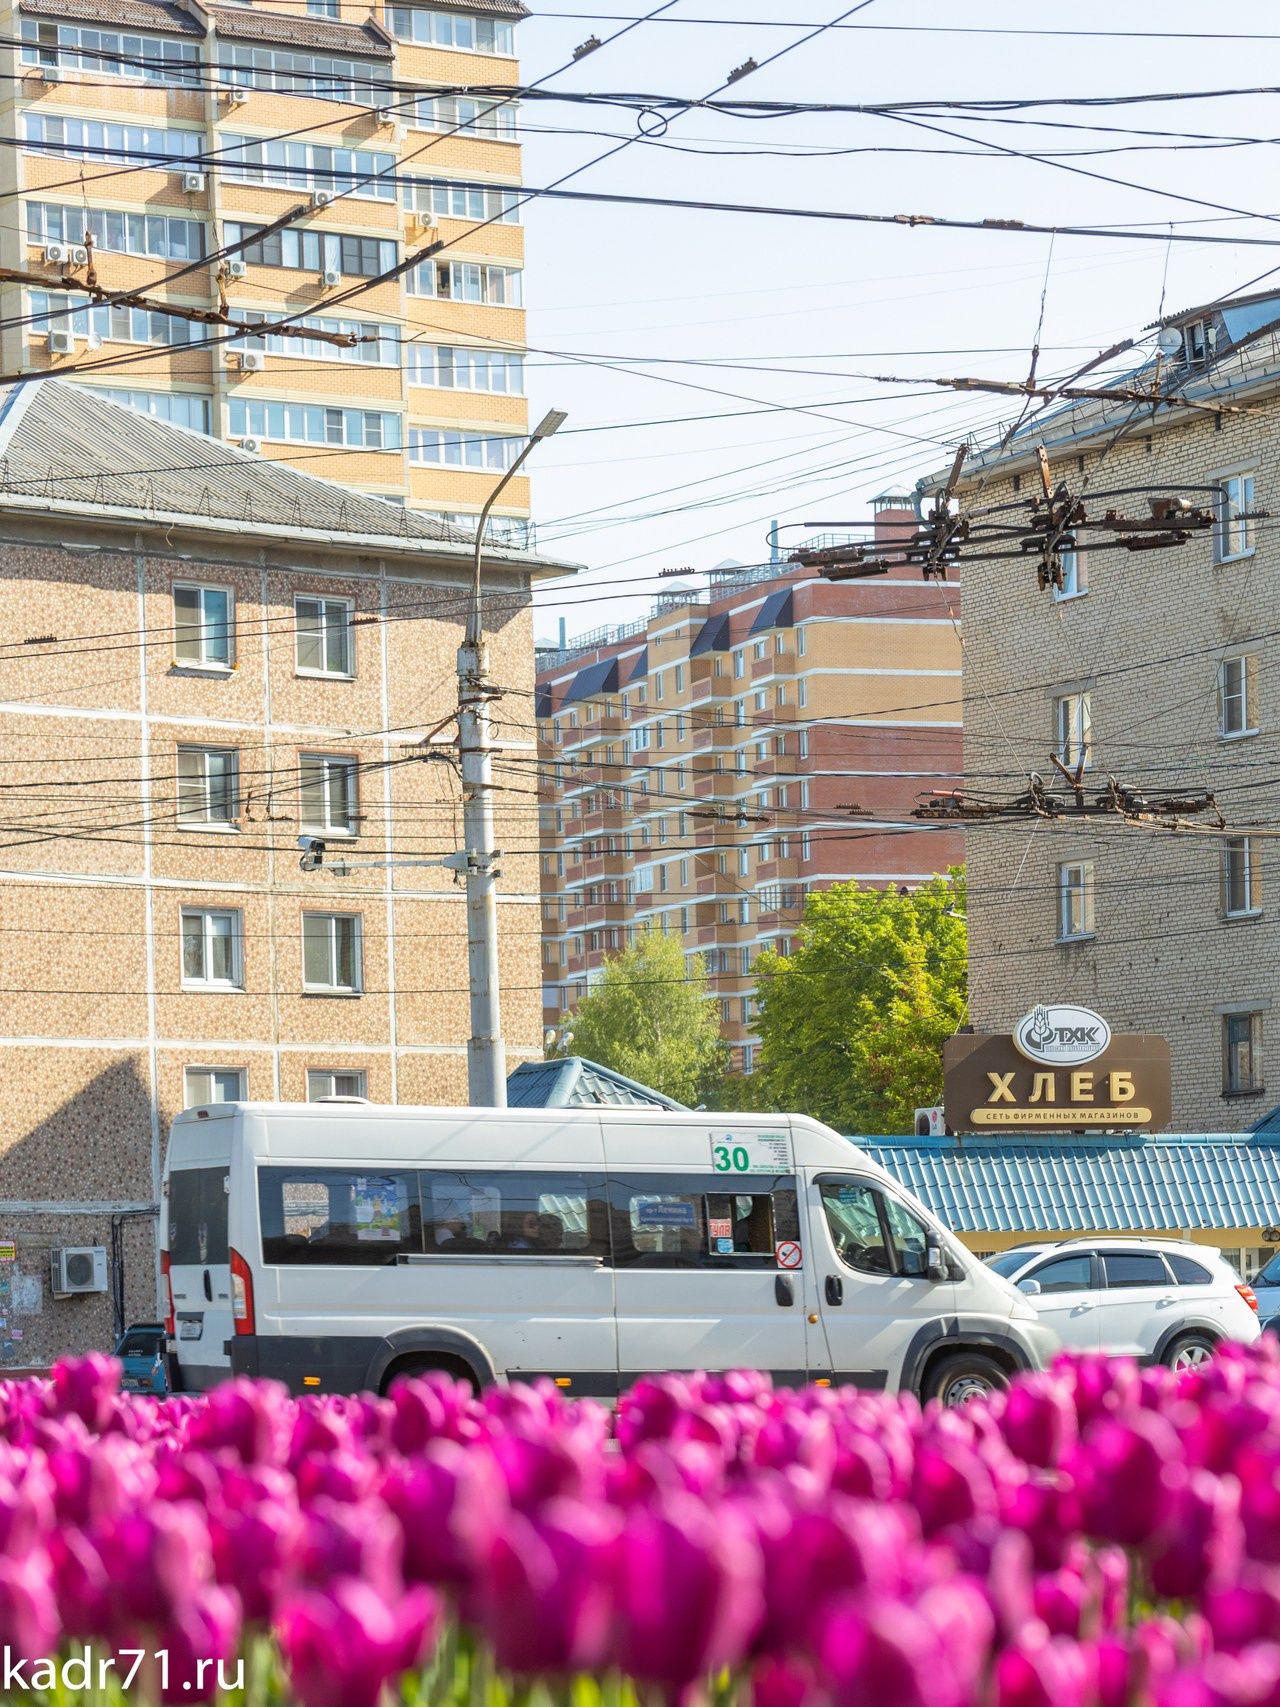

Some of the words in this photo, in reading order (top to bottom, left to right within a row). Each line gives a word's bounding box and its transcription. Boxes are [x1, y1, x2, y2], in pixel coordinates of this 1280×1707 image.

[986, 1071, 1136, 1103] ХЛЕБ
[1013, 1112, 1077, 1120] ФИРМЕННЫХ
[714, 1146, 749, 1172] 30
